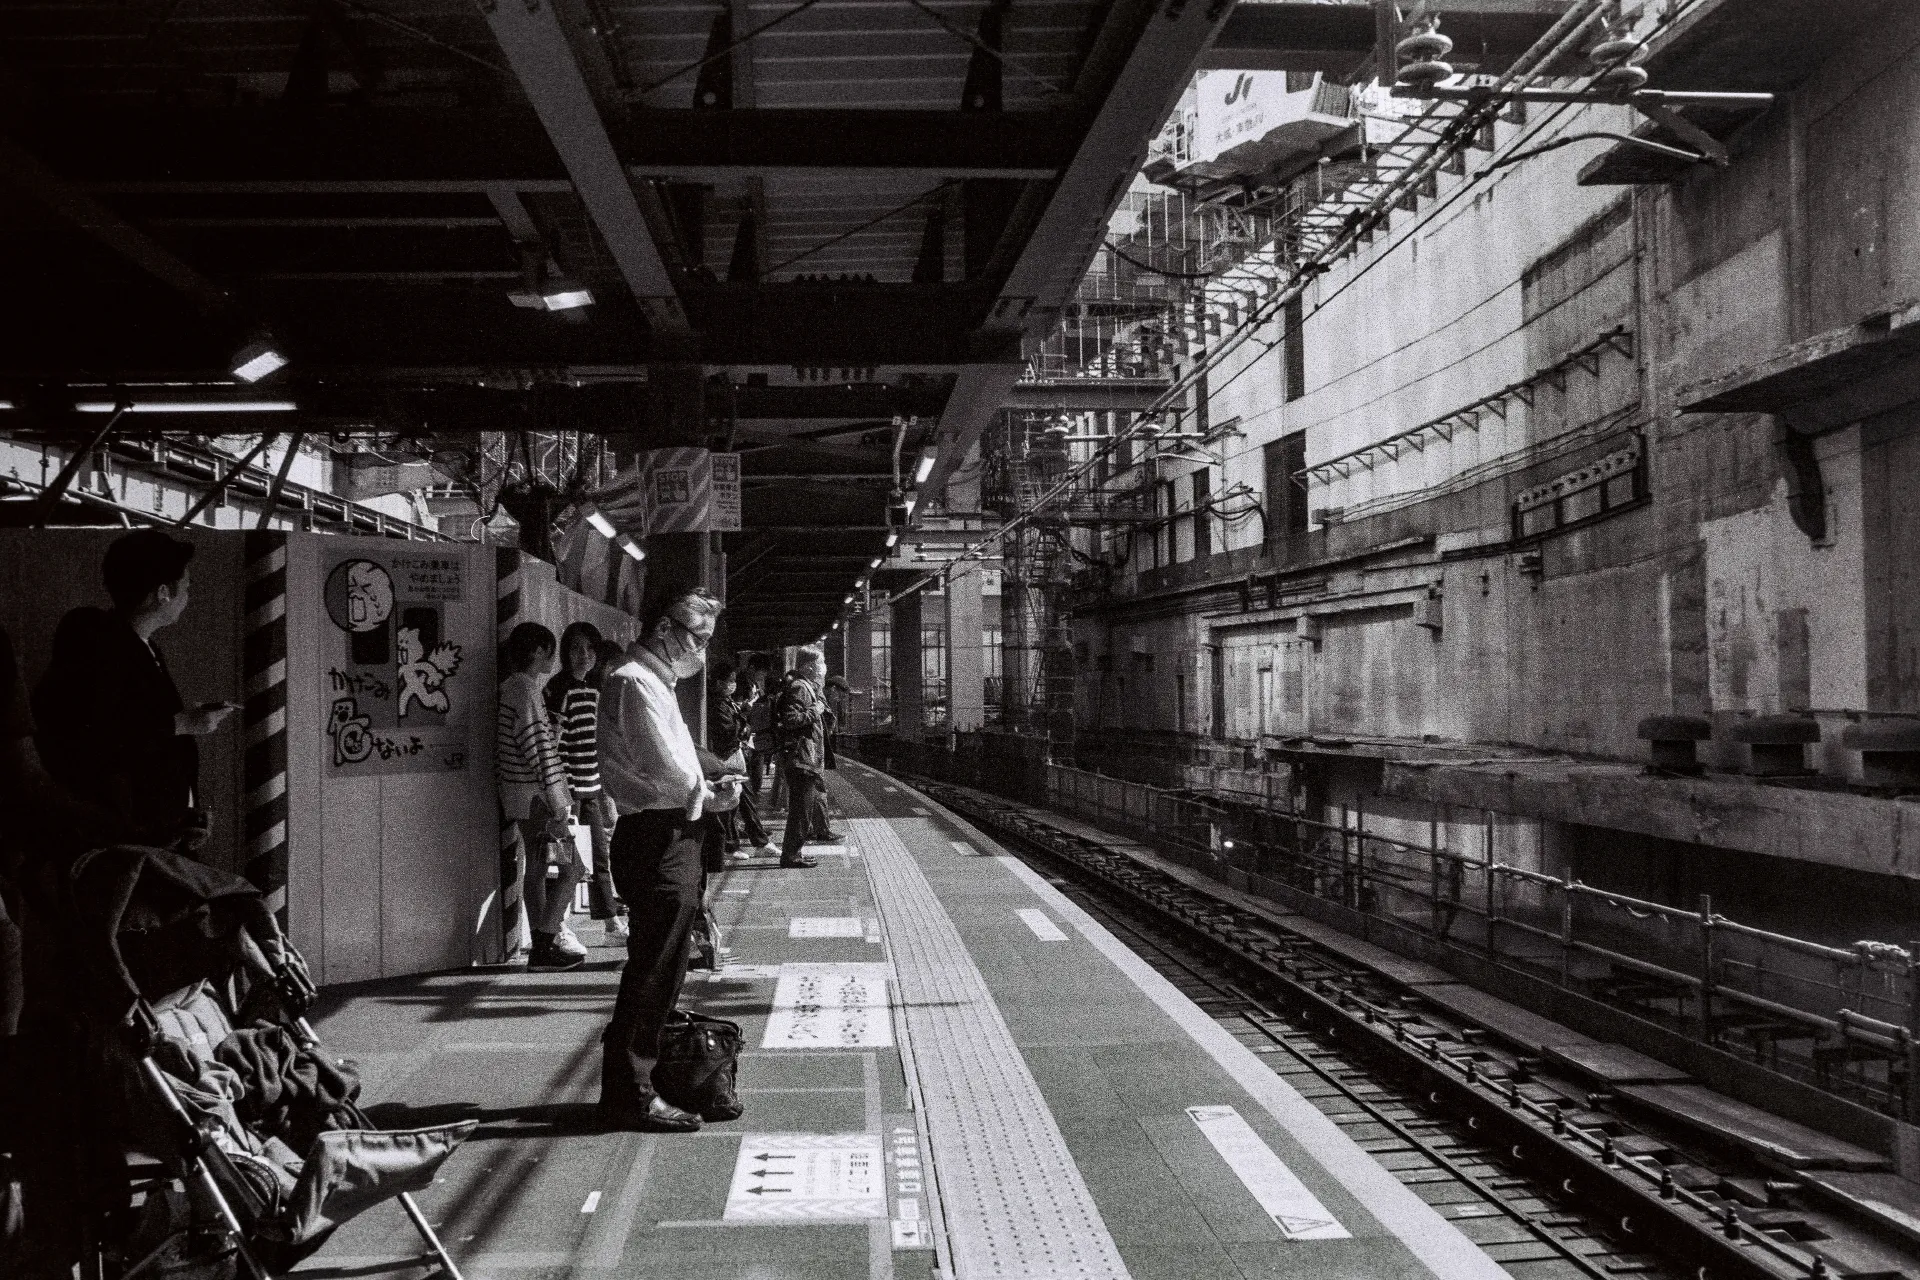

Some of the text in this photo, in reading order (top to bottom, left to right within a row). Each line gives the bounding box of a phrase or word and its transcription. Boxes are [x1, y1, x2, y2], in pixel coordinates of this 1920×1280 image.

[658, 471, 687, 482] STOP
[408, 571, 460, 584] やめましょう
[328, 667, 391, 701] かけこみ
